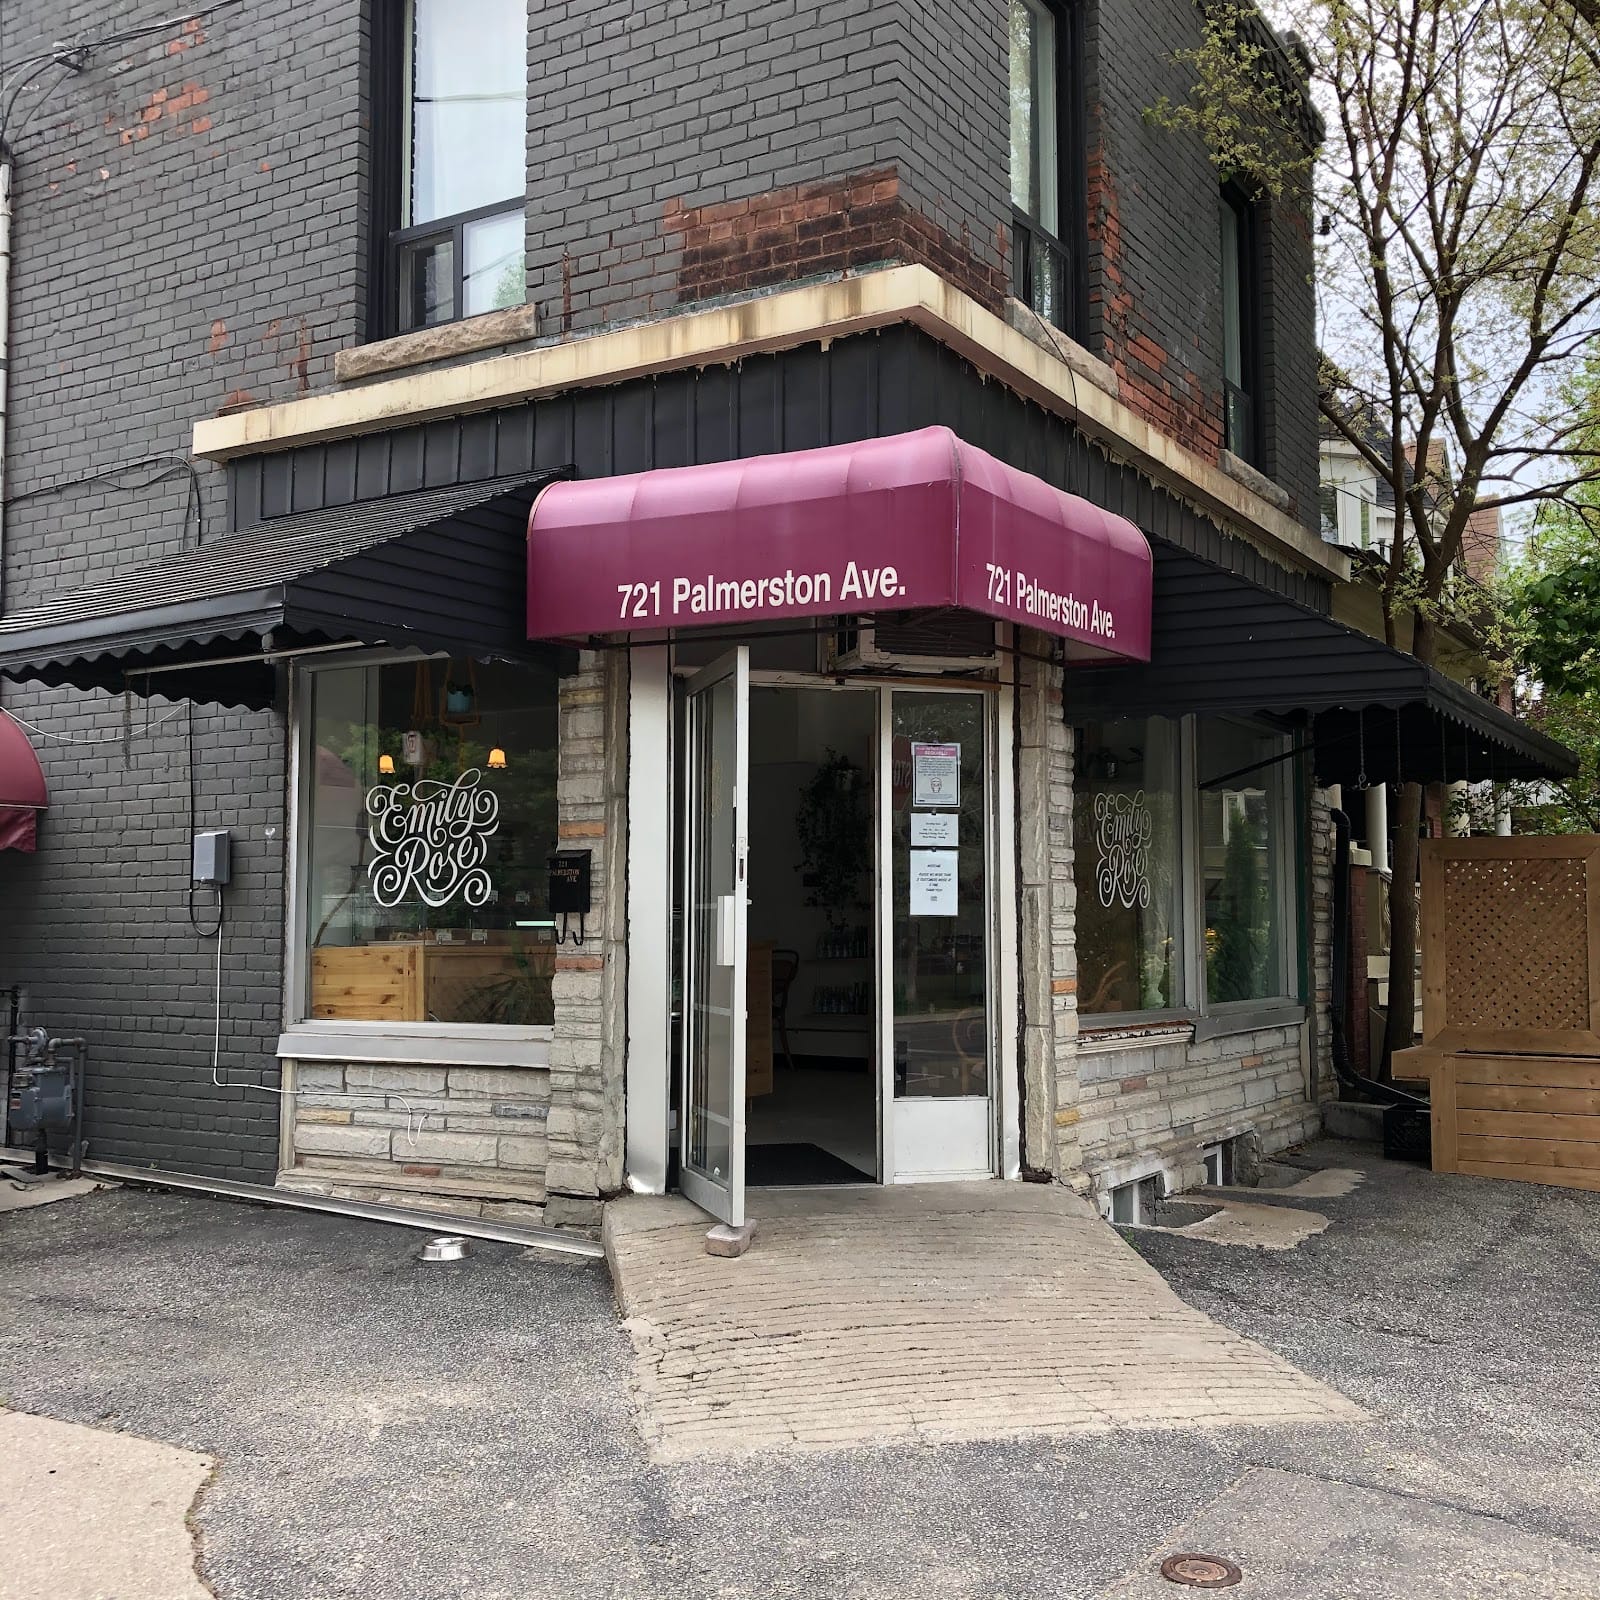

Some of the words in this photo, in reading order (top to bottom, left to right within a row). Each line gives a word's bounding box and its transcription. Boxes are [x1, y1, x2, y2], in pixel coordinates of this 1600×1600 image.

[617, 581, 661, 618] 721
[673, 570, 831, 614] Palmerston
[840, 561, 906, 600] Ave.
[986, 563, 1011, 606] 721
[1016, 572, 1088, 631] Palmerston
[1090, 599, 1116, 639] Ave.
[366, 768, 499, 847] Emily
[1094, 790, 1152, 855] Emily
[373, 836, 492, 908] Rose
[1099, 845, 1151, 909] Rose
